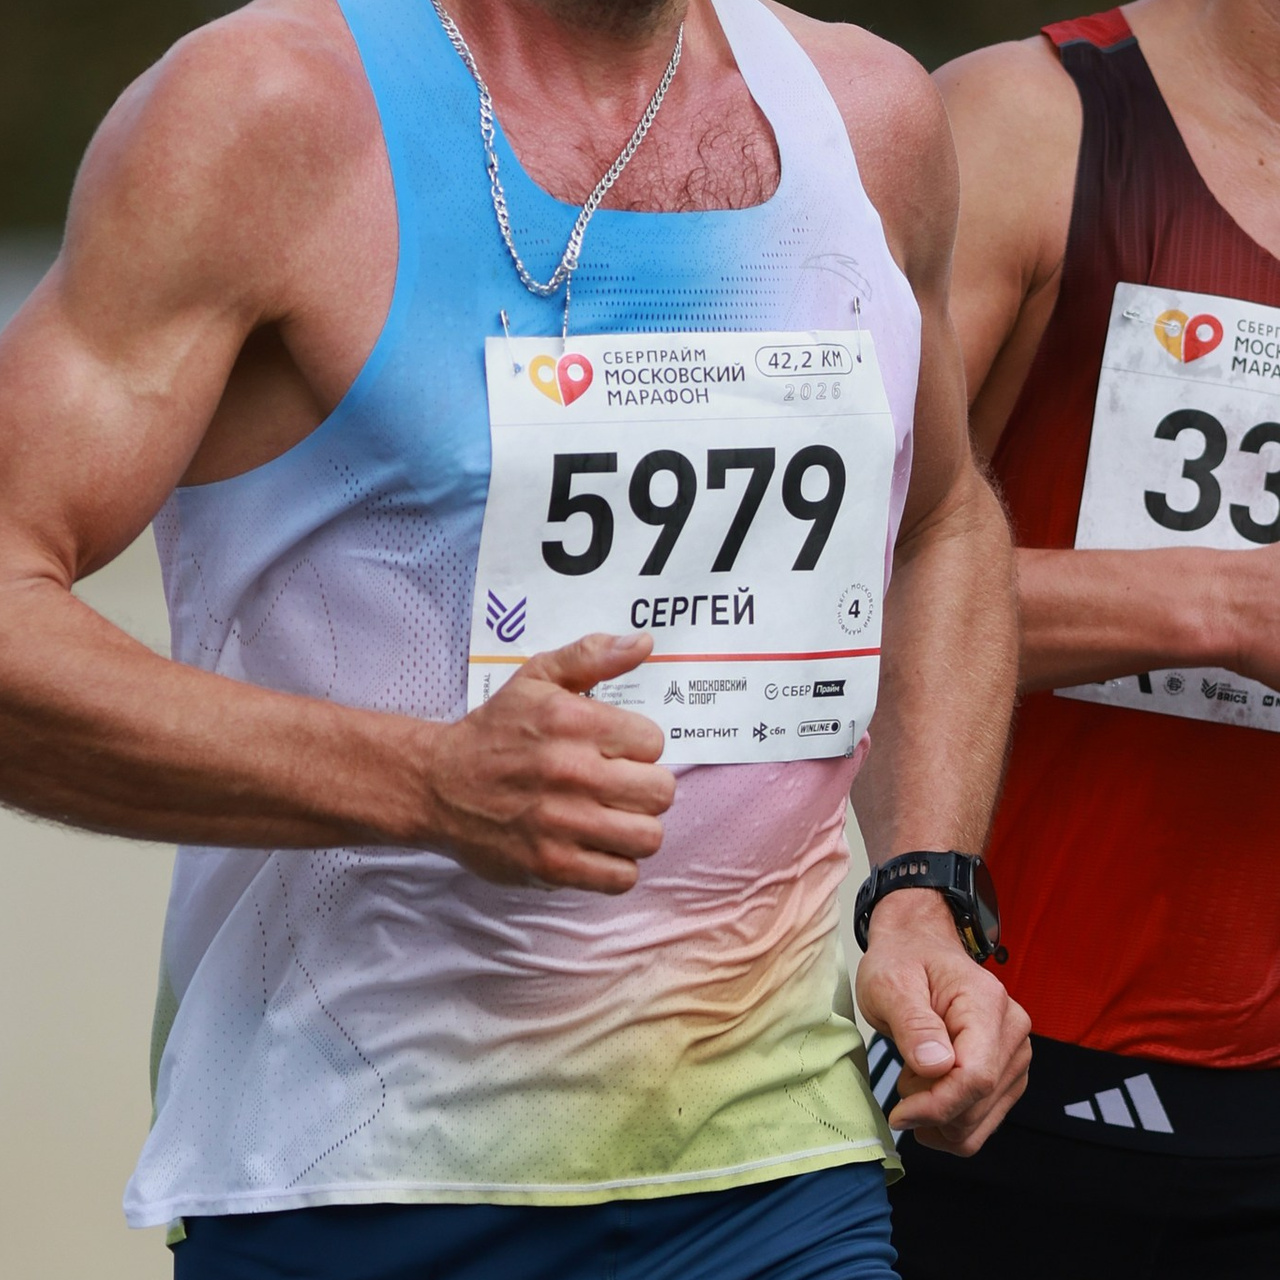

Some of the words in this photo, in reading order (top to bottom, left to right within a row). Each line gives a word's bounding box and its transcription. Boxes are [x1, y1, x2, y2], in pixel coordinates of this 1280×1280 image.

[603, 347, 706, 365] СБЕРПРАЙМ
[768, 351, 812, 372] 42,2
[605, 363, 746, 386] МОСКОВСКИЙ
[607, 388, 709, 406] МАРАФОН
[783, 382, 842, 402] 2026
[541, 444, 846, 576] 5979
[630, 587, 755, 629] СЕРГЕЙ
[848, 599, 861, 618] 4
[688, 676, 747, 692] МОСКОВСКИЙ
[782, 685, 811, 697] СБЕР
[688, 692, 717, 705] СПОРТ
[1216, 692, 1248, 705] BRICS
[800, 722, 831, 733] WINLINE
